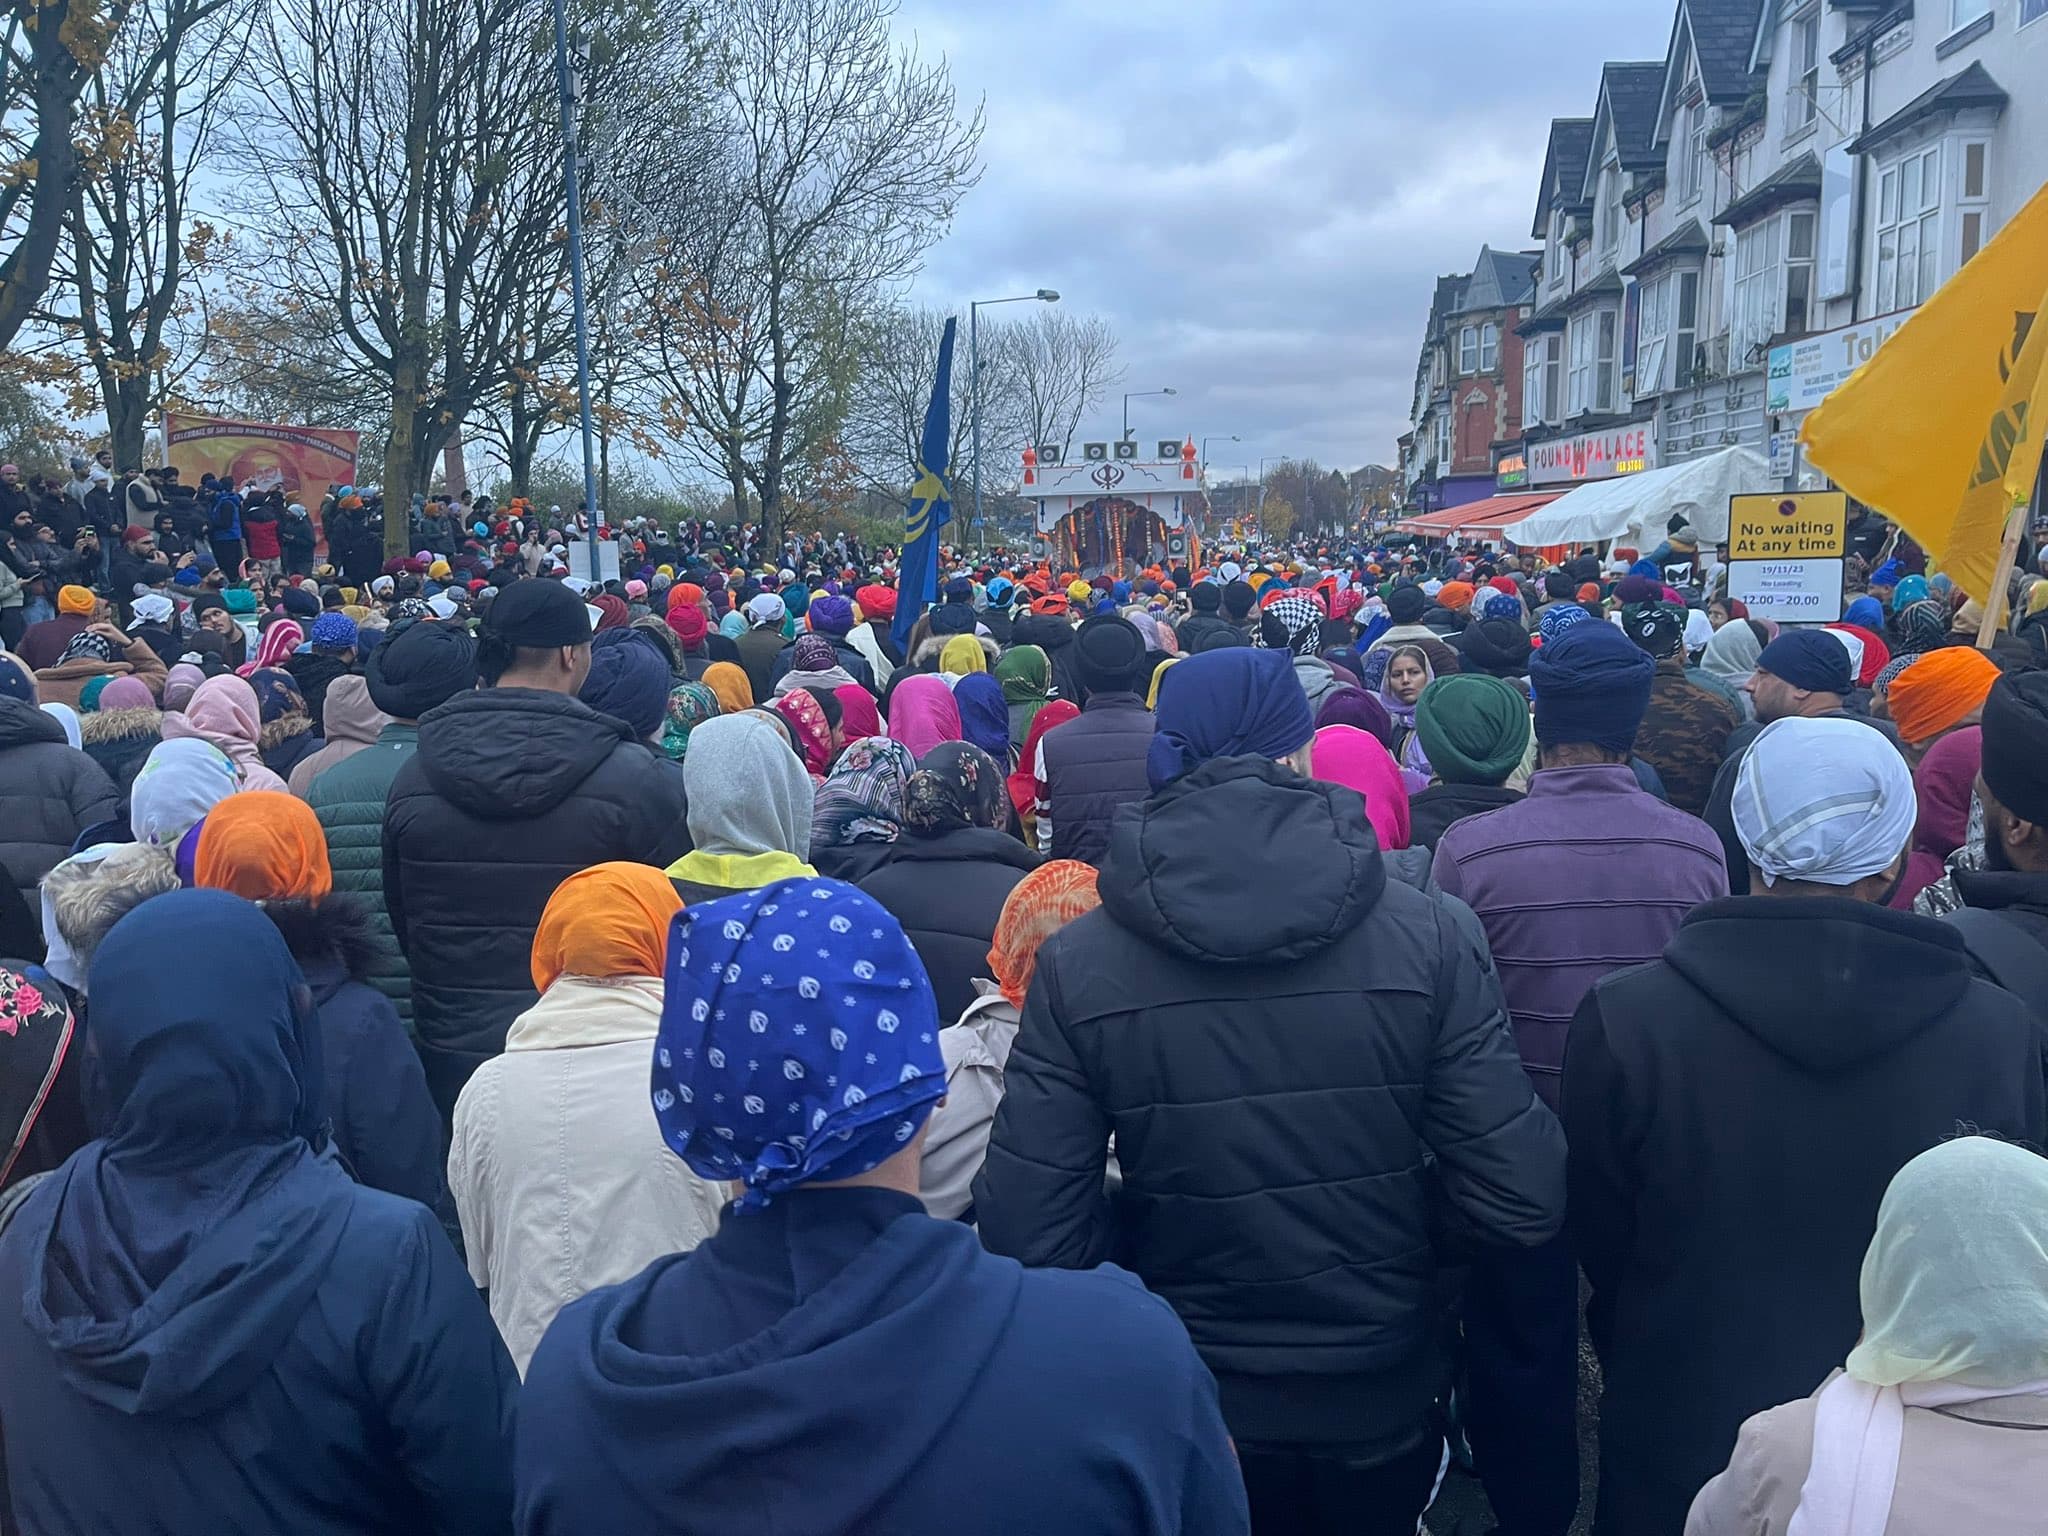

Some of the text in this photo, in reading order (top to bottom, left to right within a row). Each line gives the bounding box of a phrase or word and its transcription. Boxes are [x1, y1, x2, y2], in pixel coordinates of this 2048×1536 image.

[1534, 444, 1571, 470] POUND
[1587, 431, 1646, 462] PALACE
[1741, 521, 1834, 536] No waiting
[1737, 538, 1837, 553] At any time
[1762, 565, 1804, 575] 19/11/23
